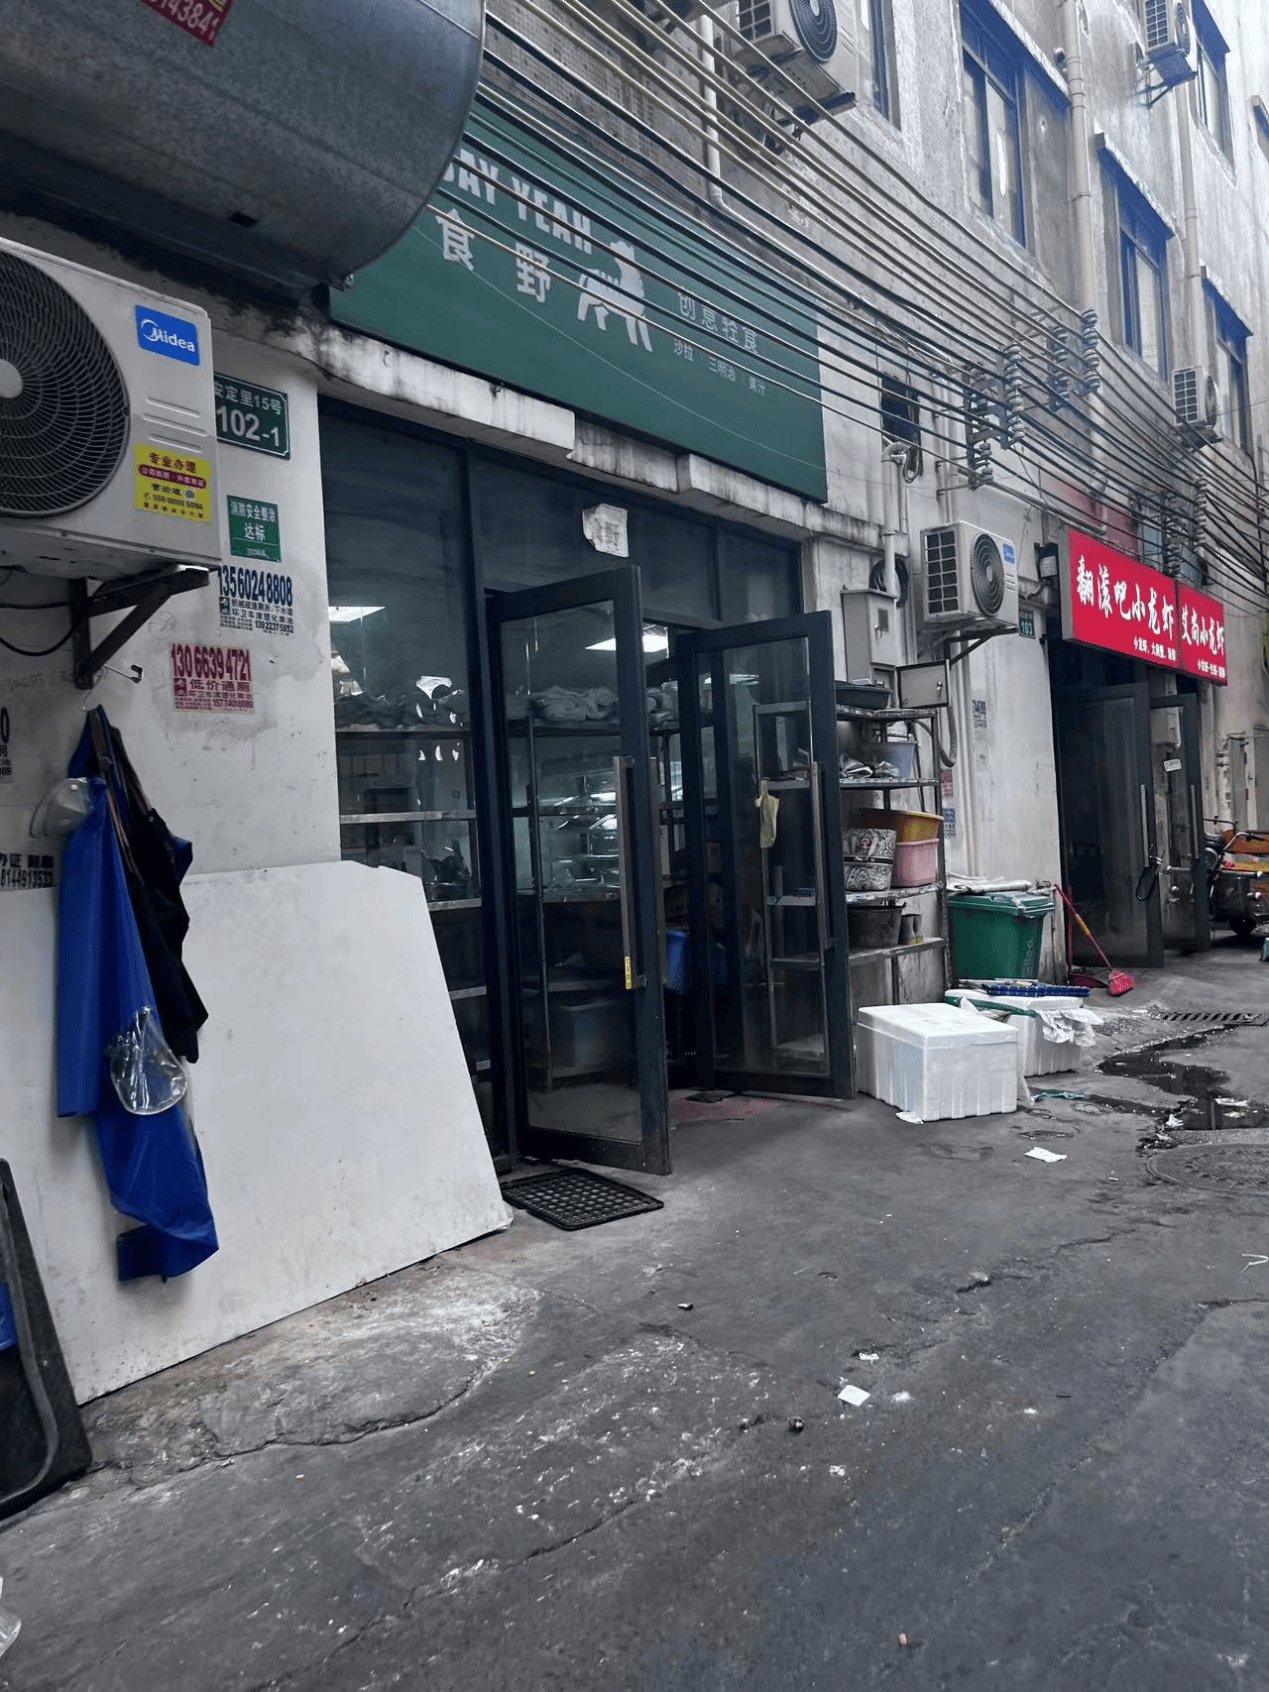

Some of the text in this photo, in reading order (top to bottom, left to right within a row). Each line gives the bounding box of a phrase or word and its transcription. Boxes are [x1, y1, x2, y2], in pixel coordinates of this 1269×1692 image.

[511, 176, 592, 255] YEAH
[141, 318, 195, 352] Midea
[674, 338, 694, 361] 沙拉
[708, 356, 736, 382] 三明治
[217, 405, 280, 447] 102-1
[244, 521, 266, 542] 达标
